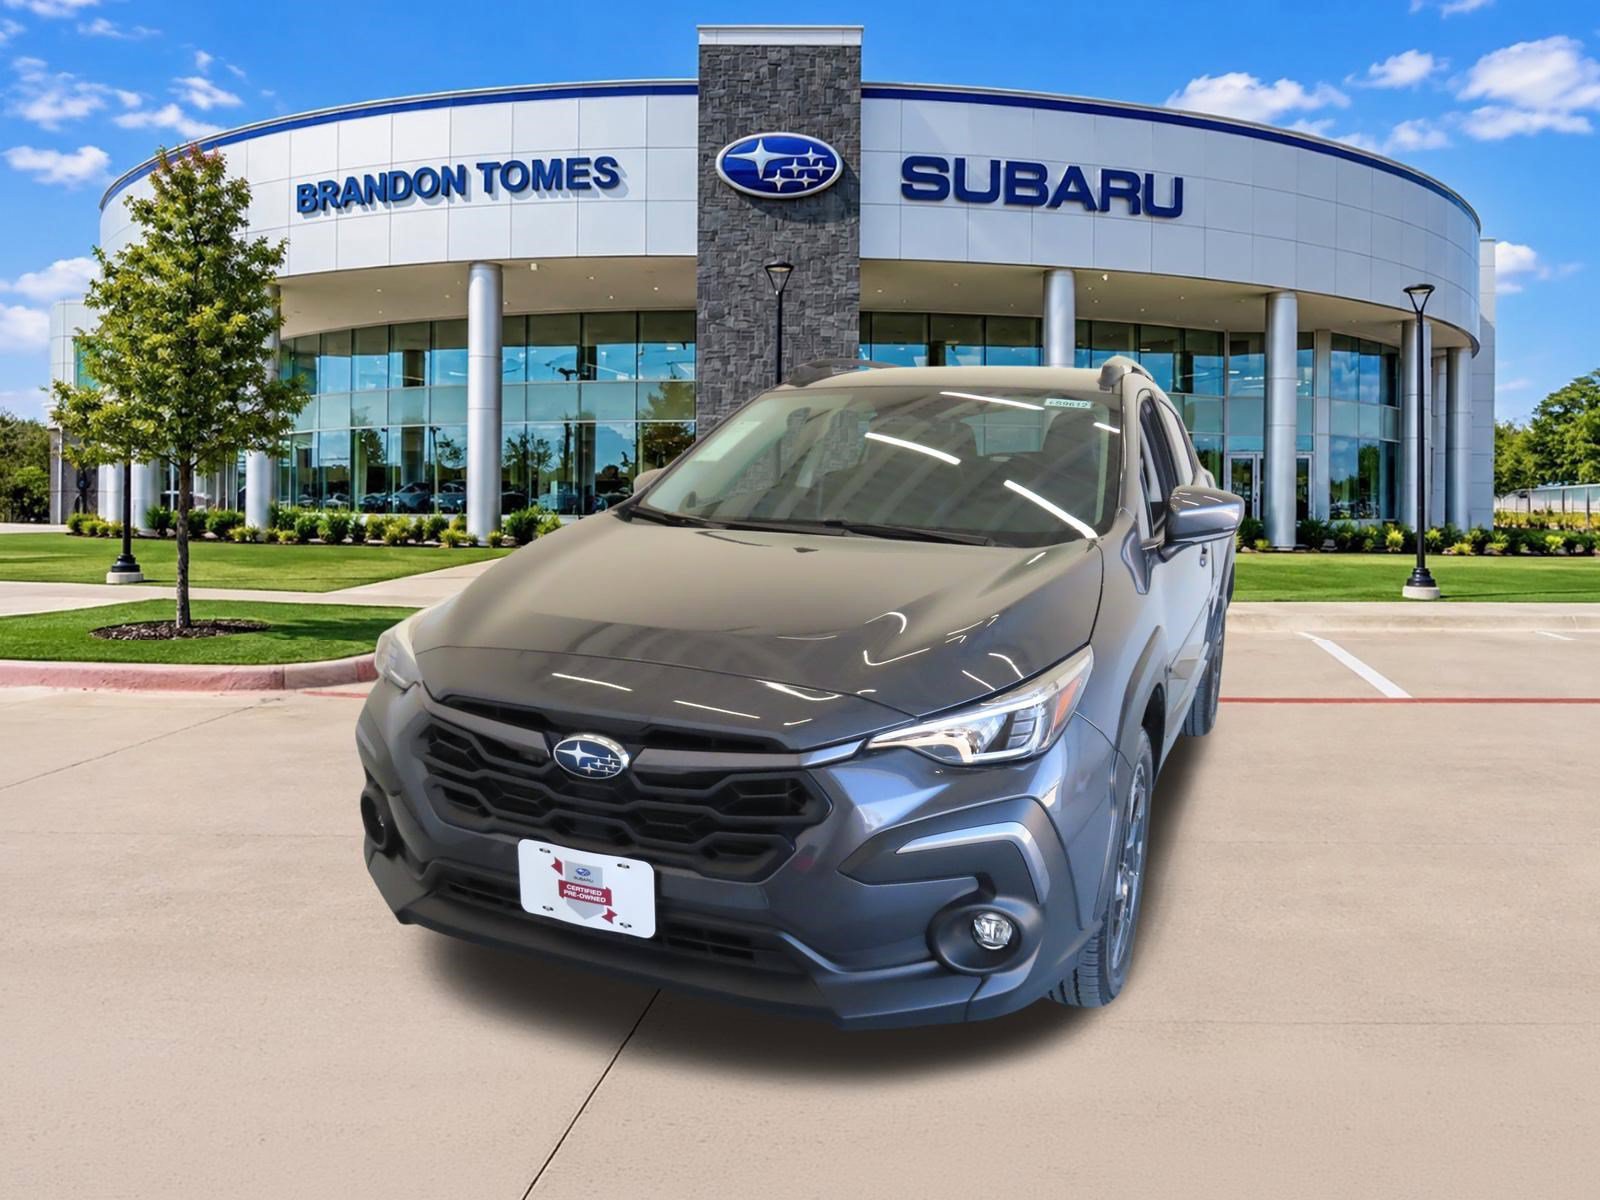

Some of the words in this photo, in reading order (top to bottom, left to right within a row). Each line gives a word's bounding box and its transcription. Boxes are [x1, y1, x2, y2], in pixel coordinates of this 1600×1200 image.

[296, 166, 468, 213] BRANDON
[476, 156, 620, 194] TOMES
[901, 155, 1184, 218] SUBARU
[563, 889, 606, 903] PRE-OWNED
[566, 884, 602, 896] CERTIFIED
